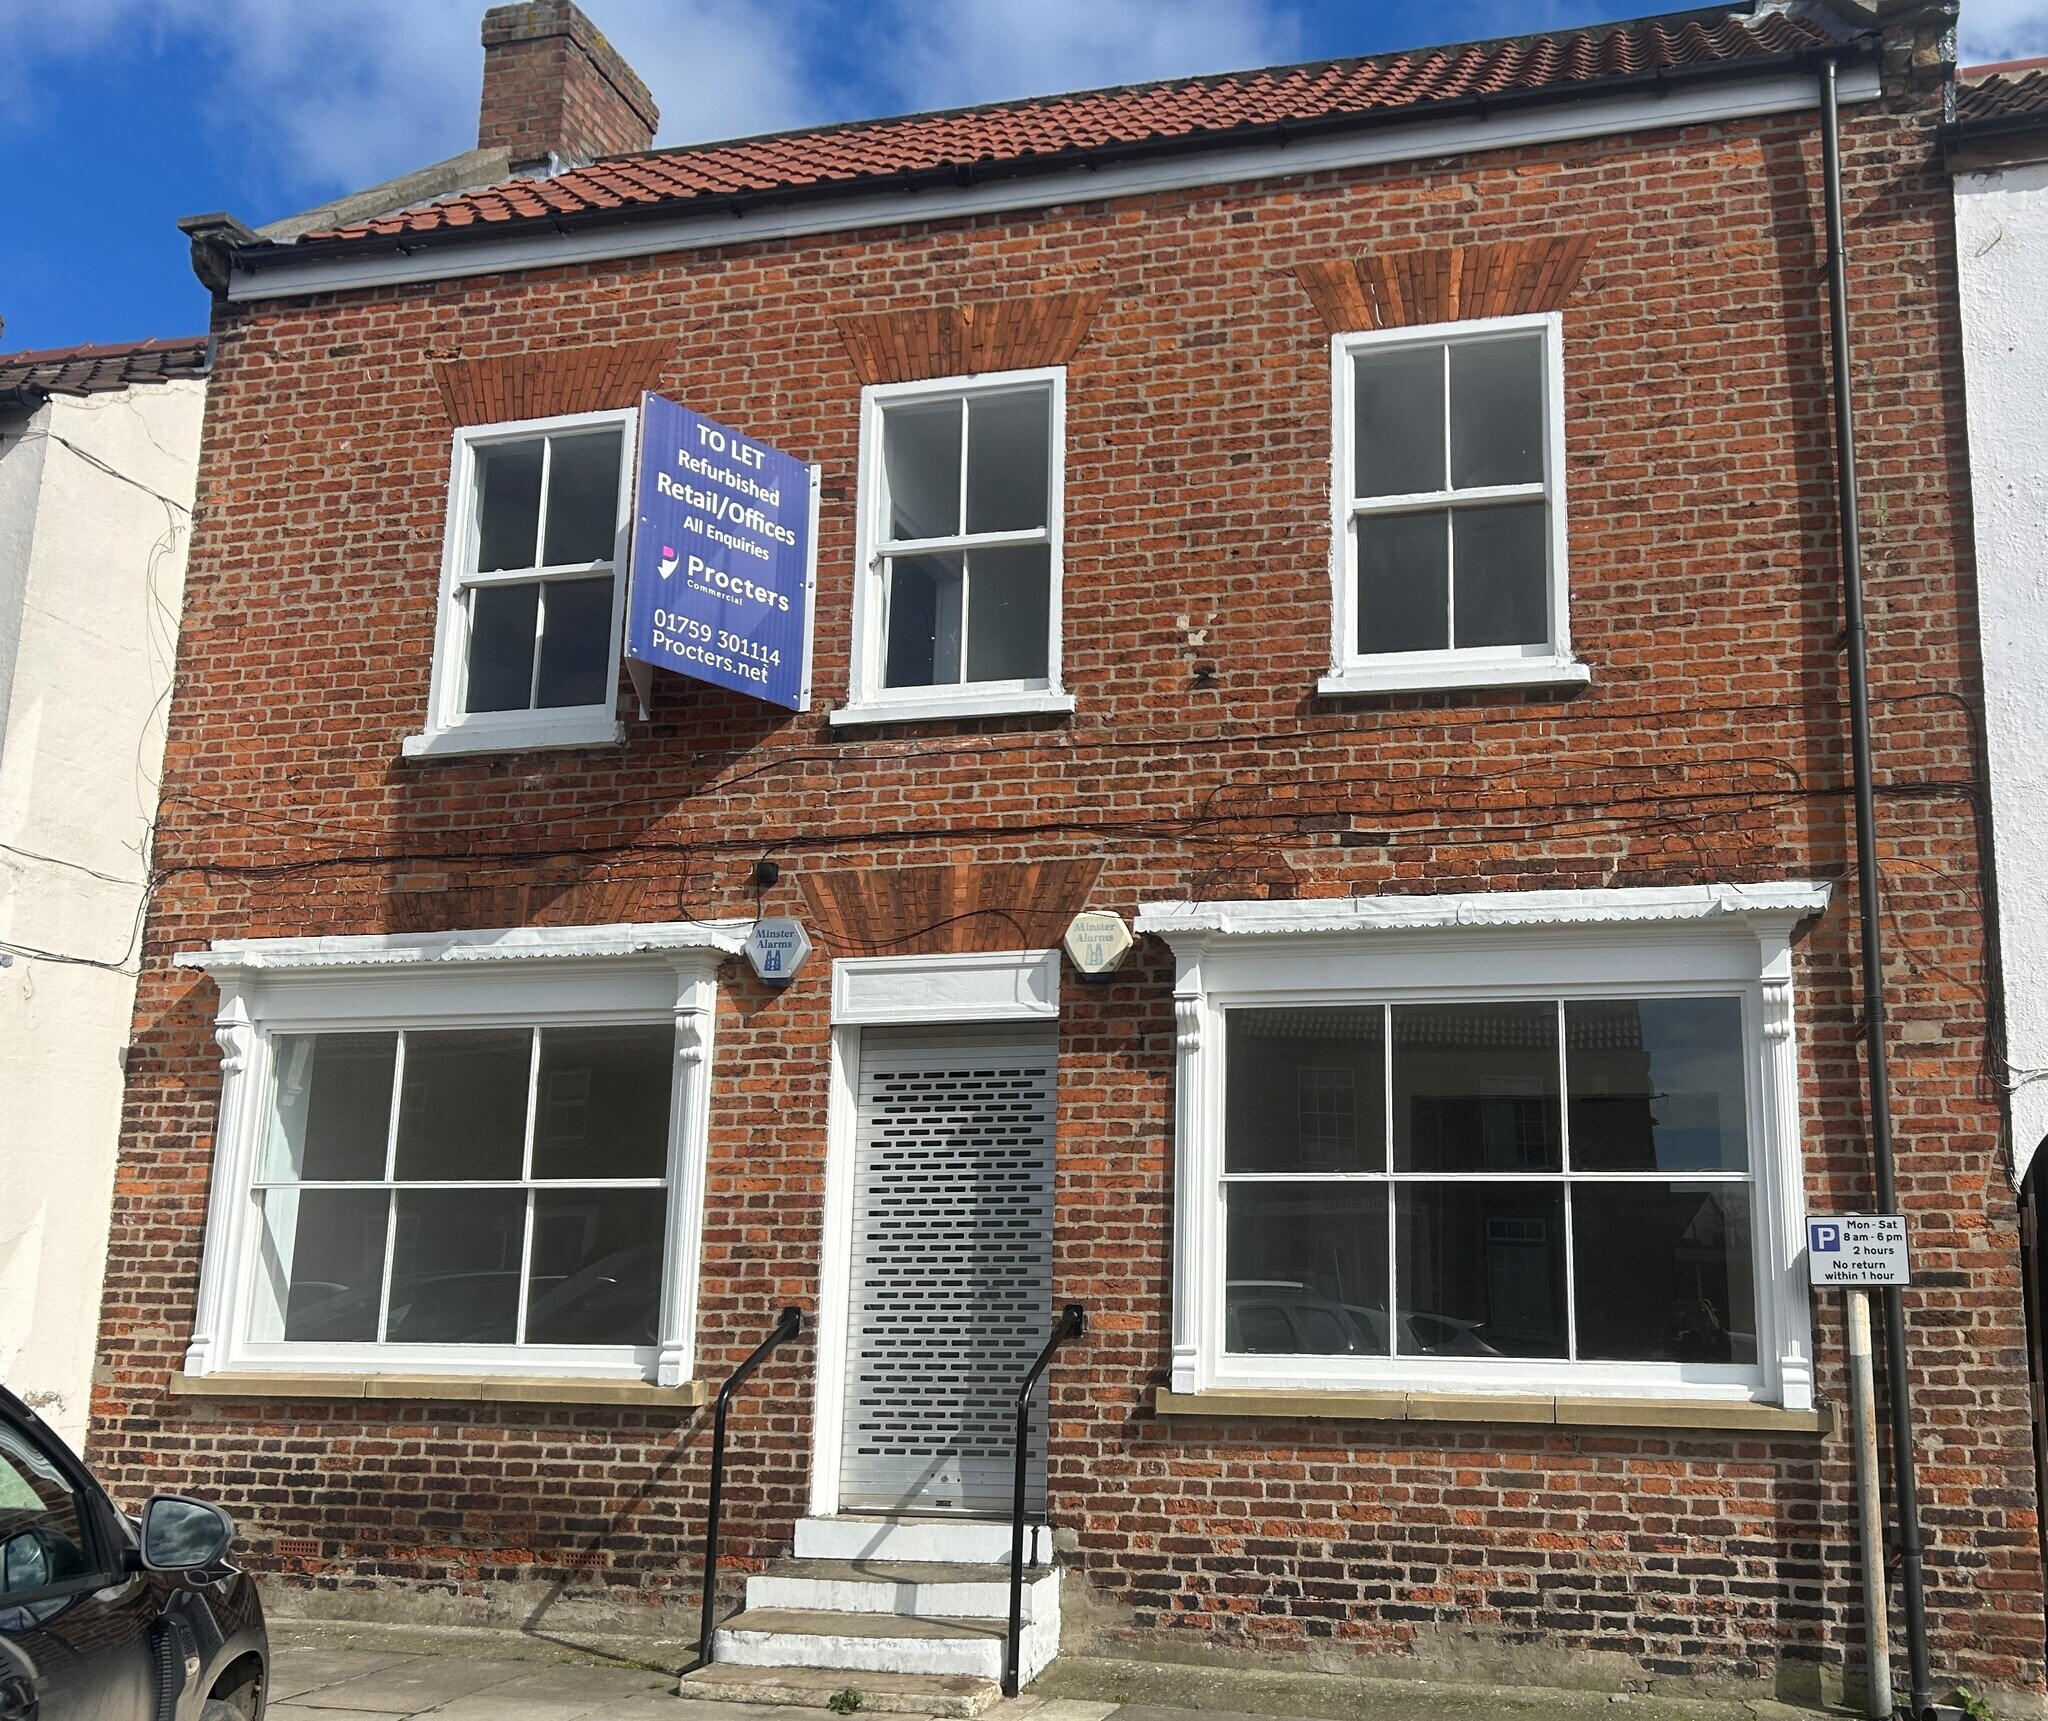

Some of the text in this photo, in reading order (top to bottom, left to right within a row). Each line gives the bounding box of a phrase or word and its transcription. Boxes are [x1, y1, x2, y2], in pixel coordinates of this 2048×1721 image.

[696, 423, 766, 470] TO LET
[678, 448, 780, 508] Refurbished
[657, 471, 796, 546] Retail/Offices
[683, 516, 770, 561] All Enquiries
[686, 579, 743, 606] Commercial
[687, 554, 790, 612] Procters
[654, 608, 781, 667] 01759 301114
[652, 629, 769, 684] Procters.net
[755, 930, 795, 938] Minster
[1074, 922, 1116, 932] Minster
[1076, 933, 1114, 942] Alarms
[757, 940, 793, 949] Alarms
[1847, 1221, 1870, 1229] Mon
[1878, 1220, 1898, 1229] Sat
[1817, 1227, 1836, 1250] P
[1853, 1246, 1895, 1255] 2 hours
[1825, 1271, 1894, 1280] within 1 hour
[1833, 1261, 1886, 1269] No return
